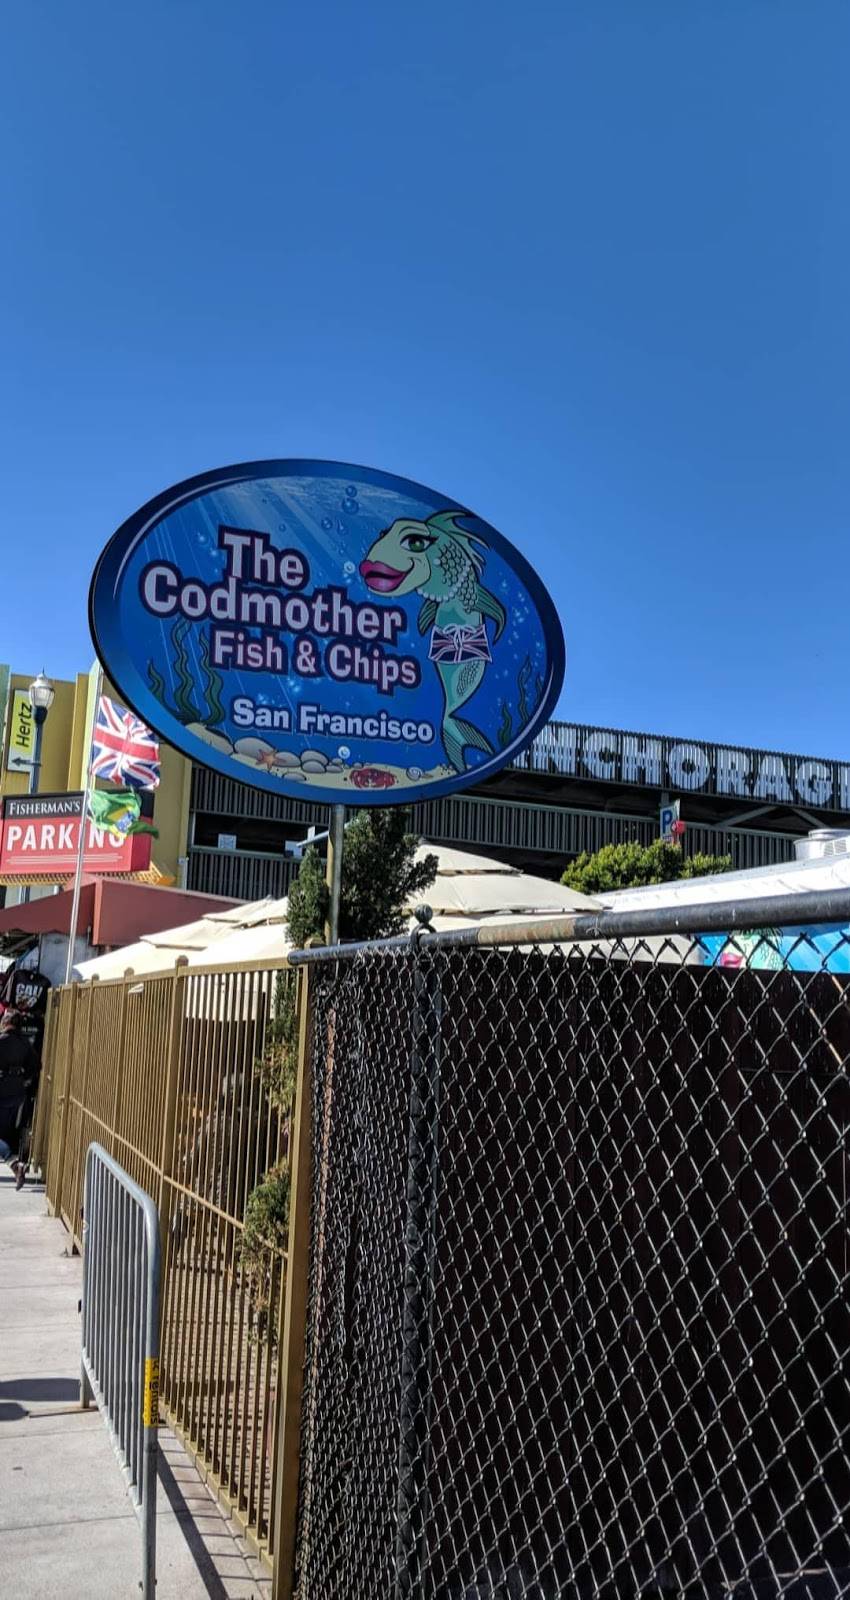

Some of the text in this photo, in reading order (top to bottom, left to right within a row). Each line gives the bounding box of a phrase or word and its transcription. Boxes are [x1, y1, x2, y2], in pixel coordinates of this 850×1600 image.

[222, 531, 304, 586] The
[143, 565, 402, 640] Codmother
[213, 630, 417, 691] Fish & Chips
[15, 702, 33, 748] Hertz
[232, 698, 433, 742] San Francisco
[662, 809, 673, 834] P
